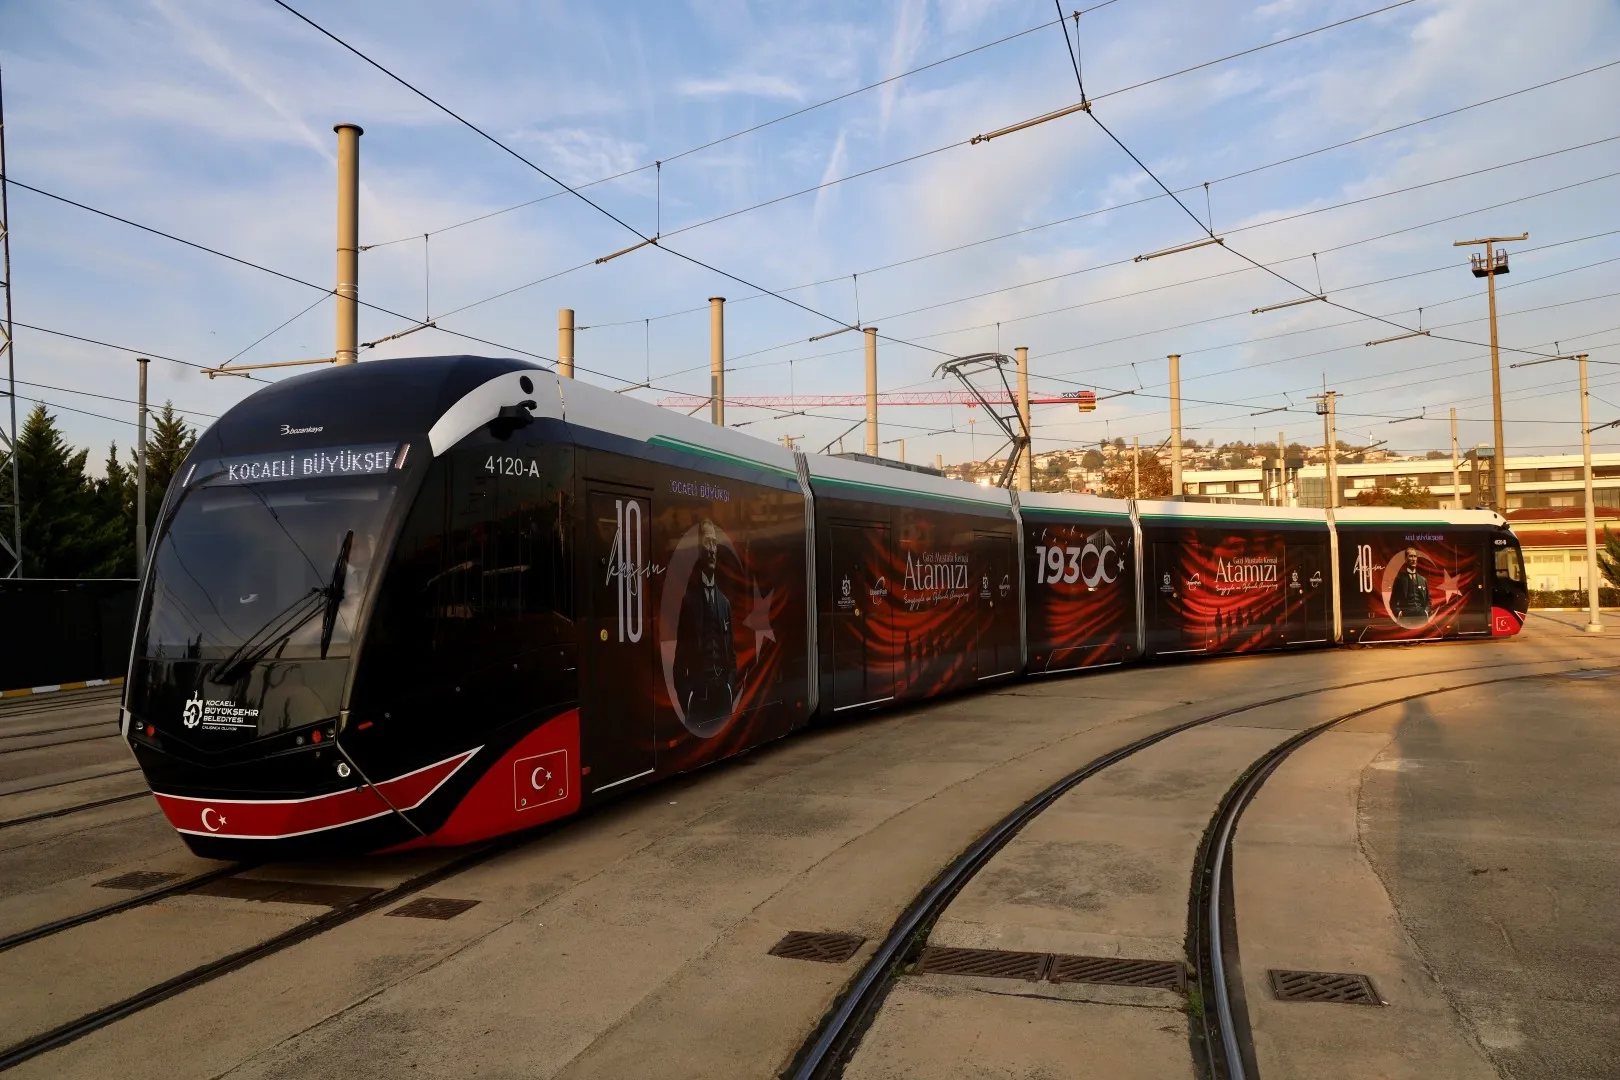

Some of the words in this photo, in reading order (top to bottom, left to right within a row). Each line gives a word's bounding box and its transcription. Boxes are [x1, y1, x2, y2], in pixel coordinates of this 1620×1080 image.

[228, 455, 295, 481] KOCAELİ
[484, 455, 540, 479] 4120-A
[669, 480, 698, 497] OCAELİ
[615, 500, 643, 643] 10
[902, 549, 969, 591] Atamızı
[1215, 556, 1278, 582] Atamızı
[1357, 544, 1373, 593] 10
[204, 707, 259, 717] BÜYÜKŞEHİR
[205, 699, 236, 707] KOCAELİ
[203, 715, 244, 723] BELEDİYESİ
